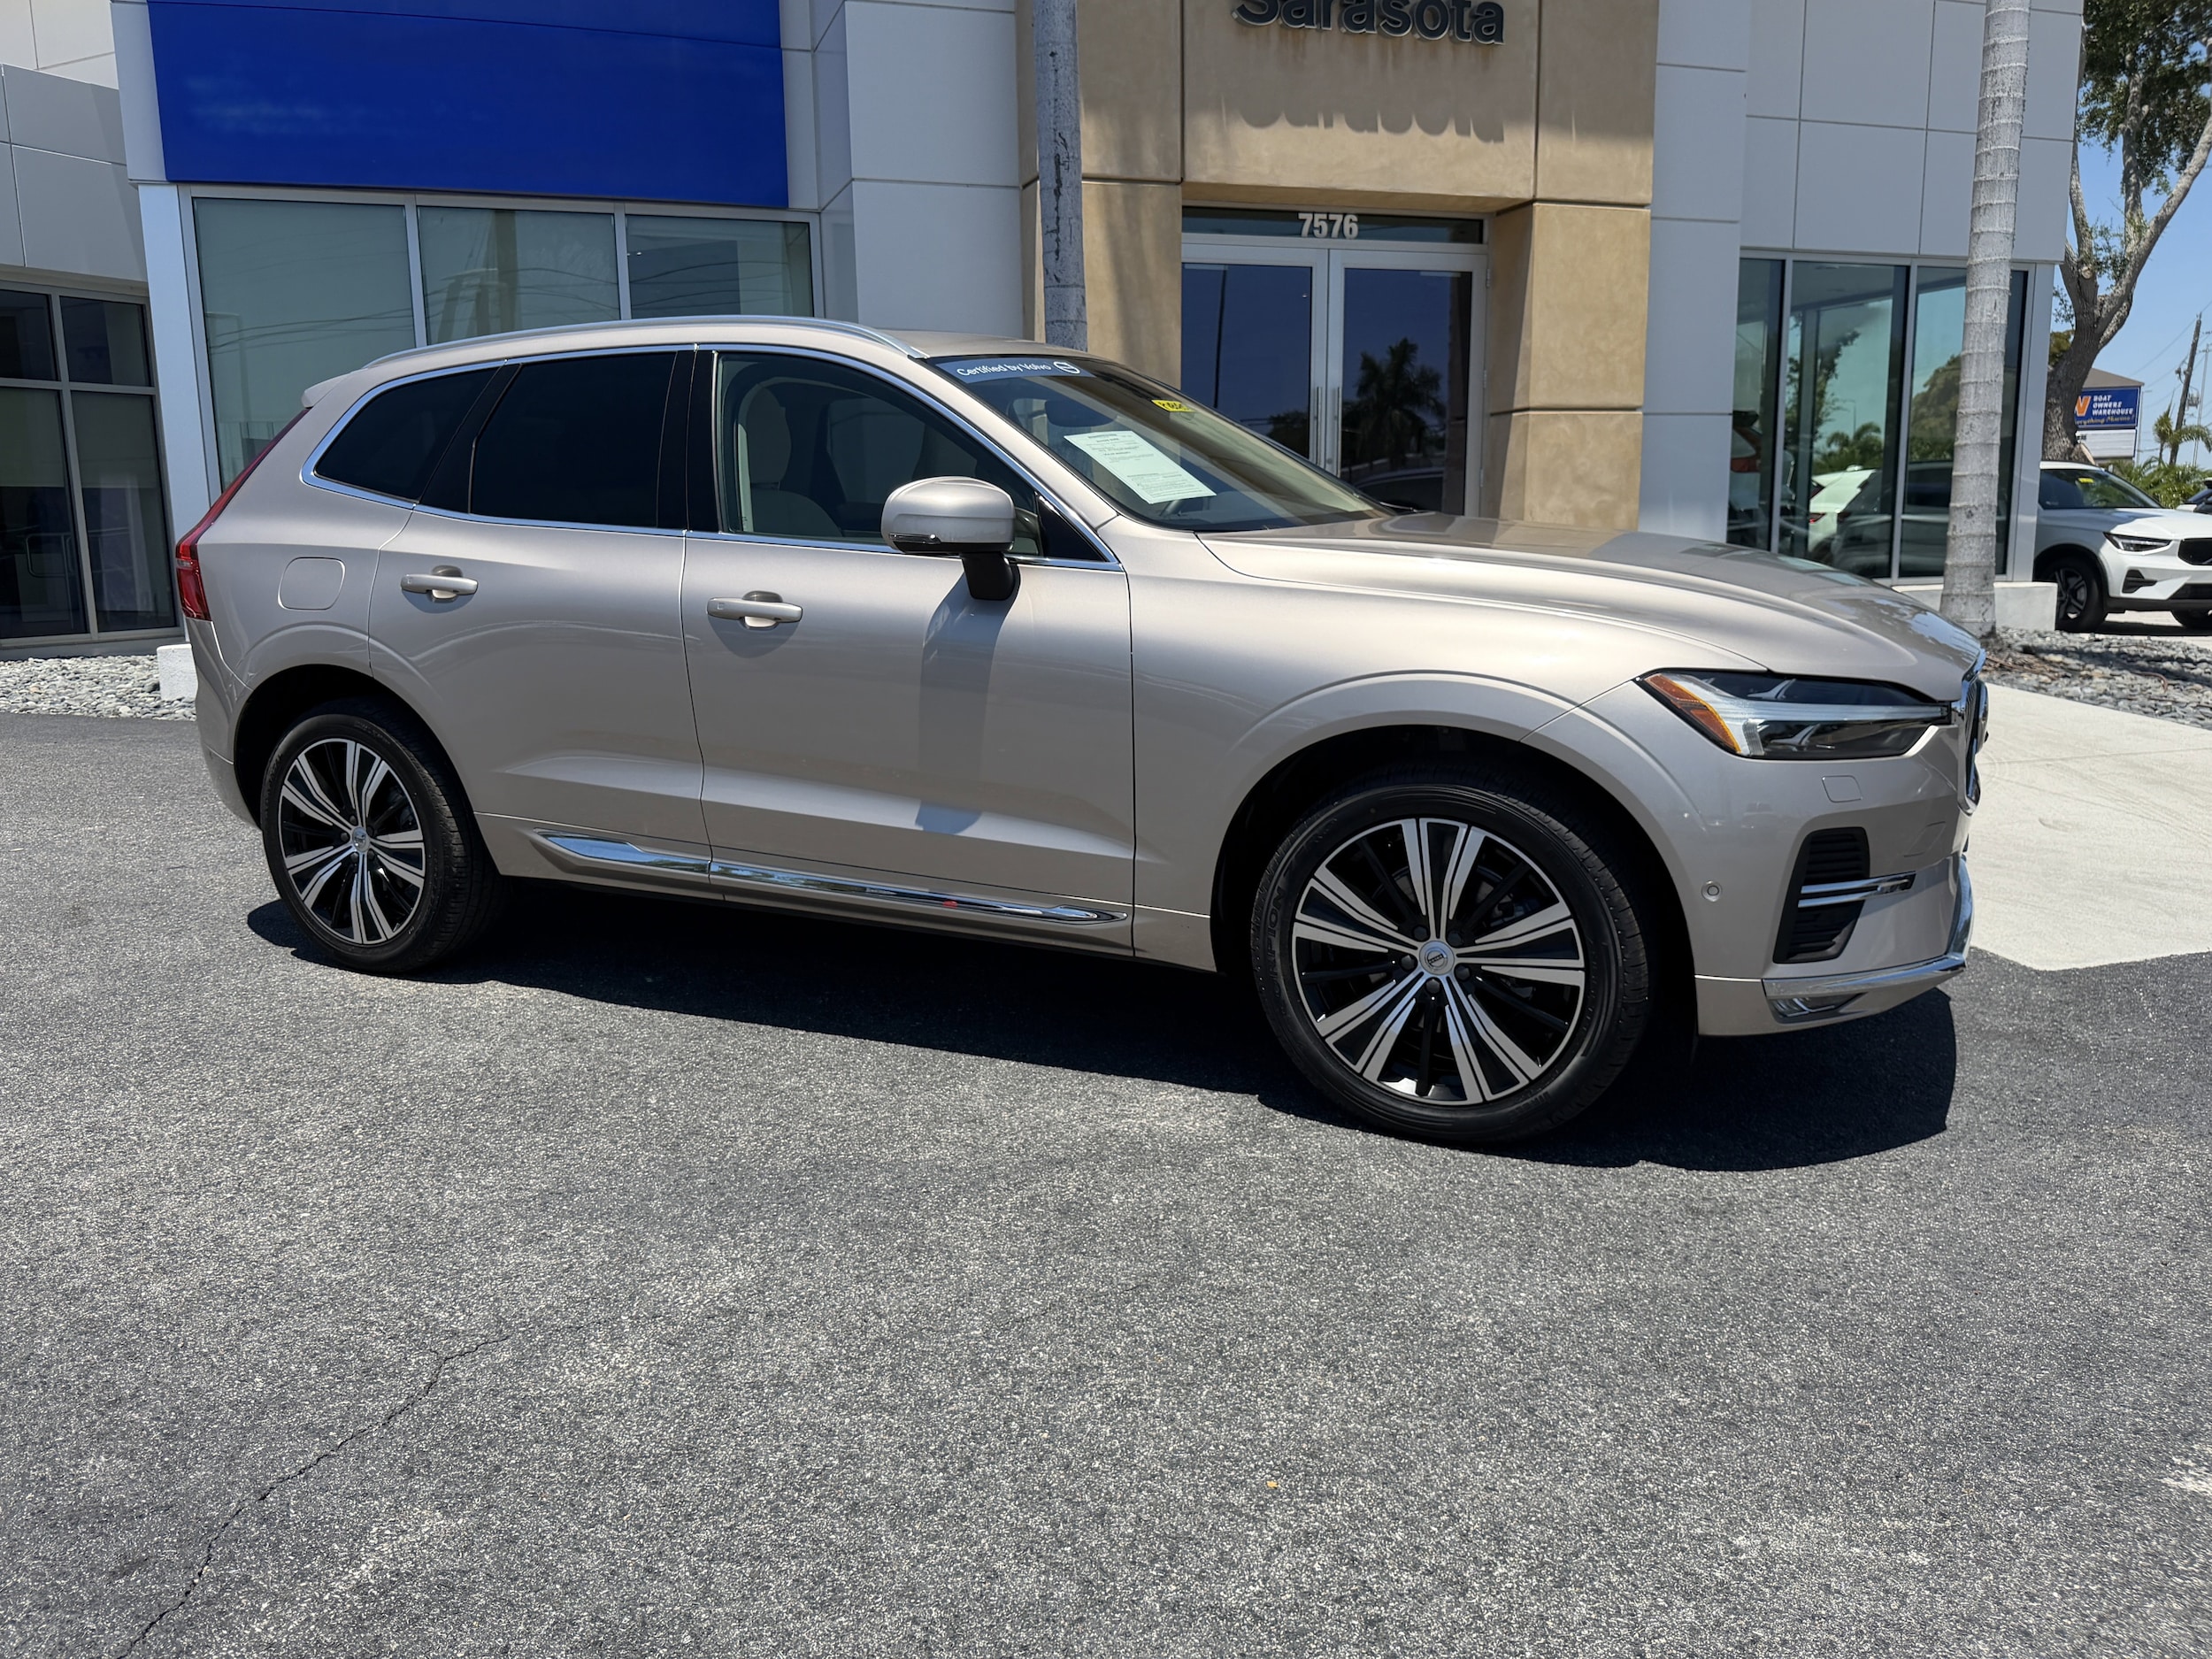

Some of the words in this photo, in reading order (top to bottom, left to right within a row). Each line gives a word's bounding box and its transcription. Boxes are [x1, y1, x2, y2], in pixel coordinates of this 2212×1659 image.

[1297, 212, 1359, 240] 7576
[956, 365, 1007, 376] Certified
[1004, 364, 1023, 373] by
